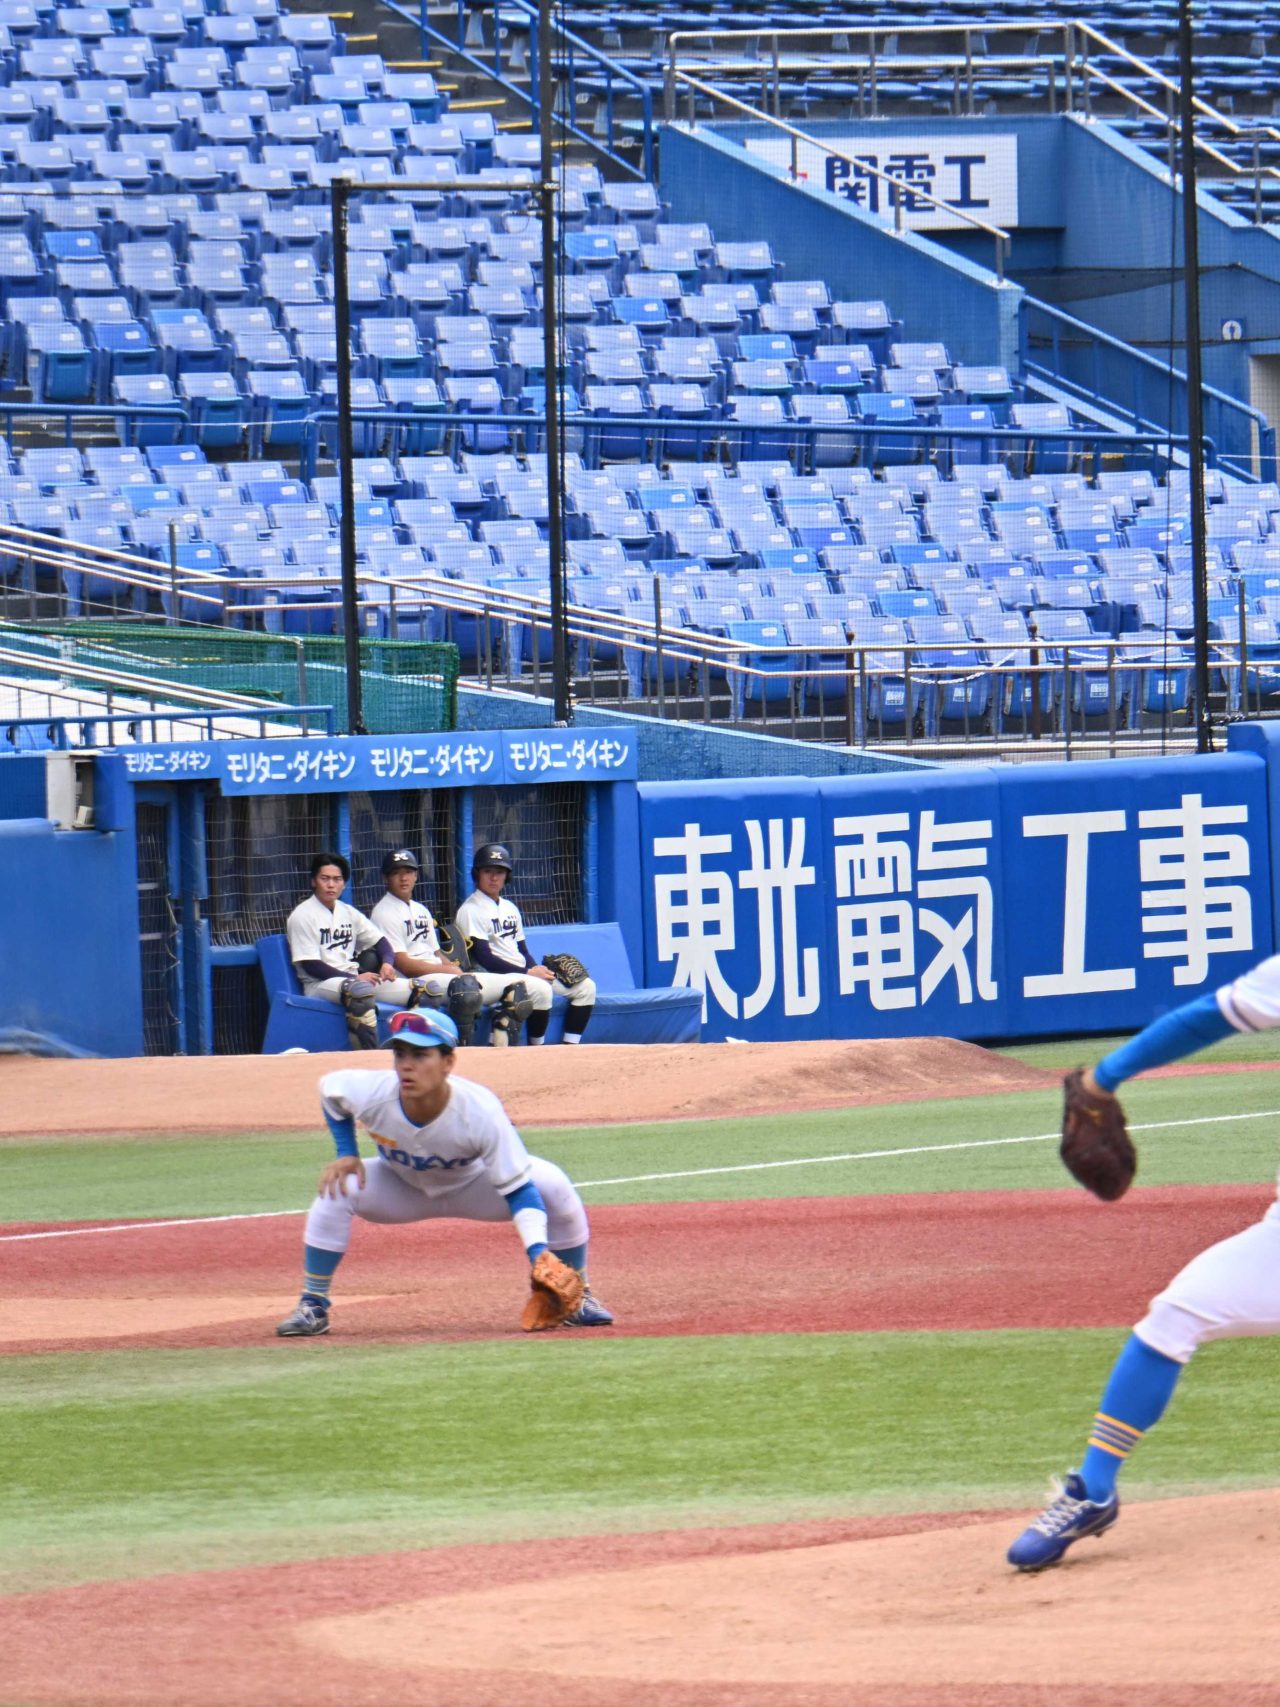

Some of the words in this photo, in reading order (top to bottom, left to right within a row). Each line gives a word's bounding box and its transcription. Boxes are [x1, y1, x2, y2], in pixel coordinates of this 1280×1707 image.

[653, 793, 1254, 1024] 東光電気工事
